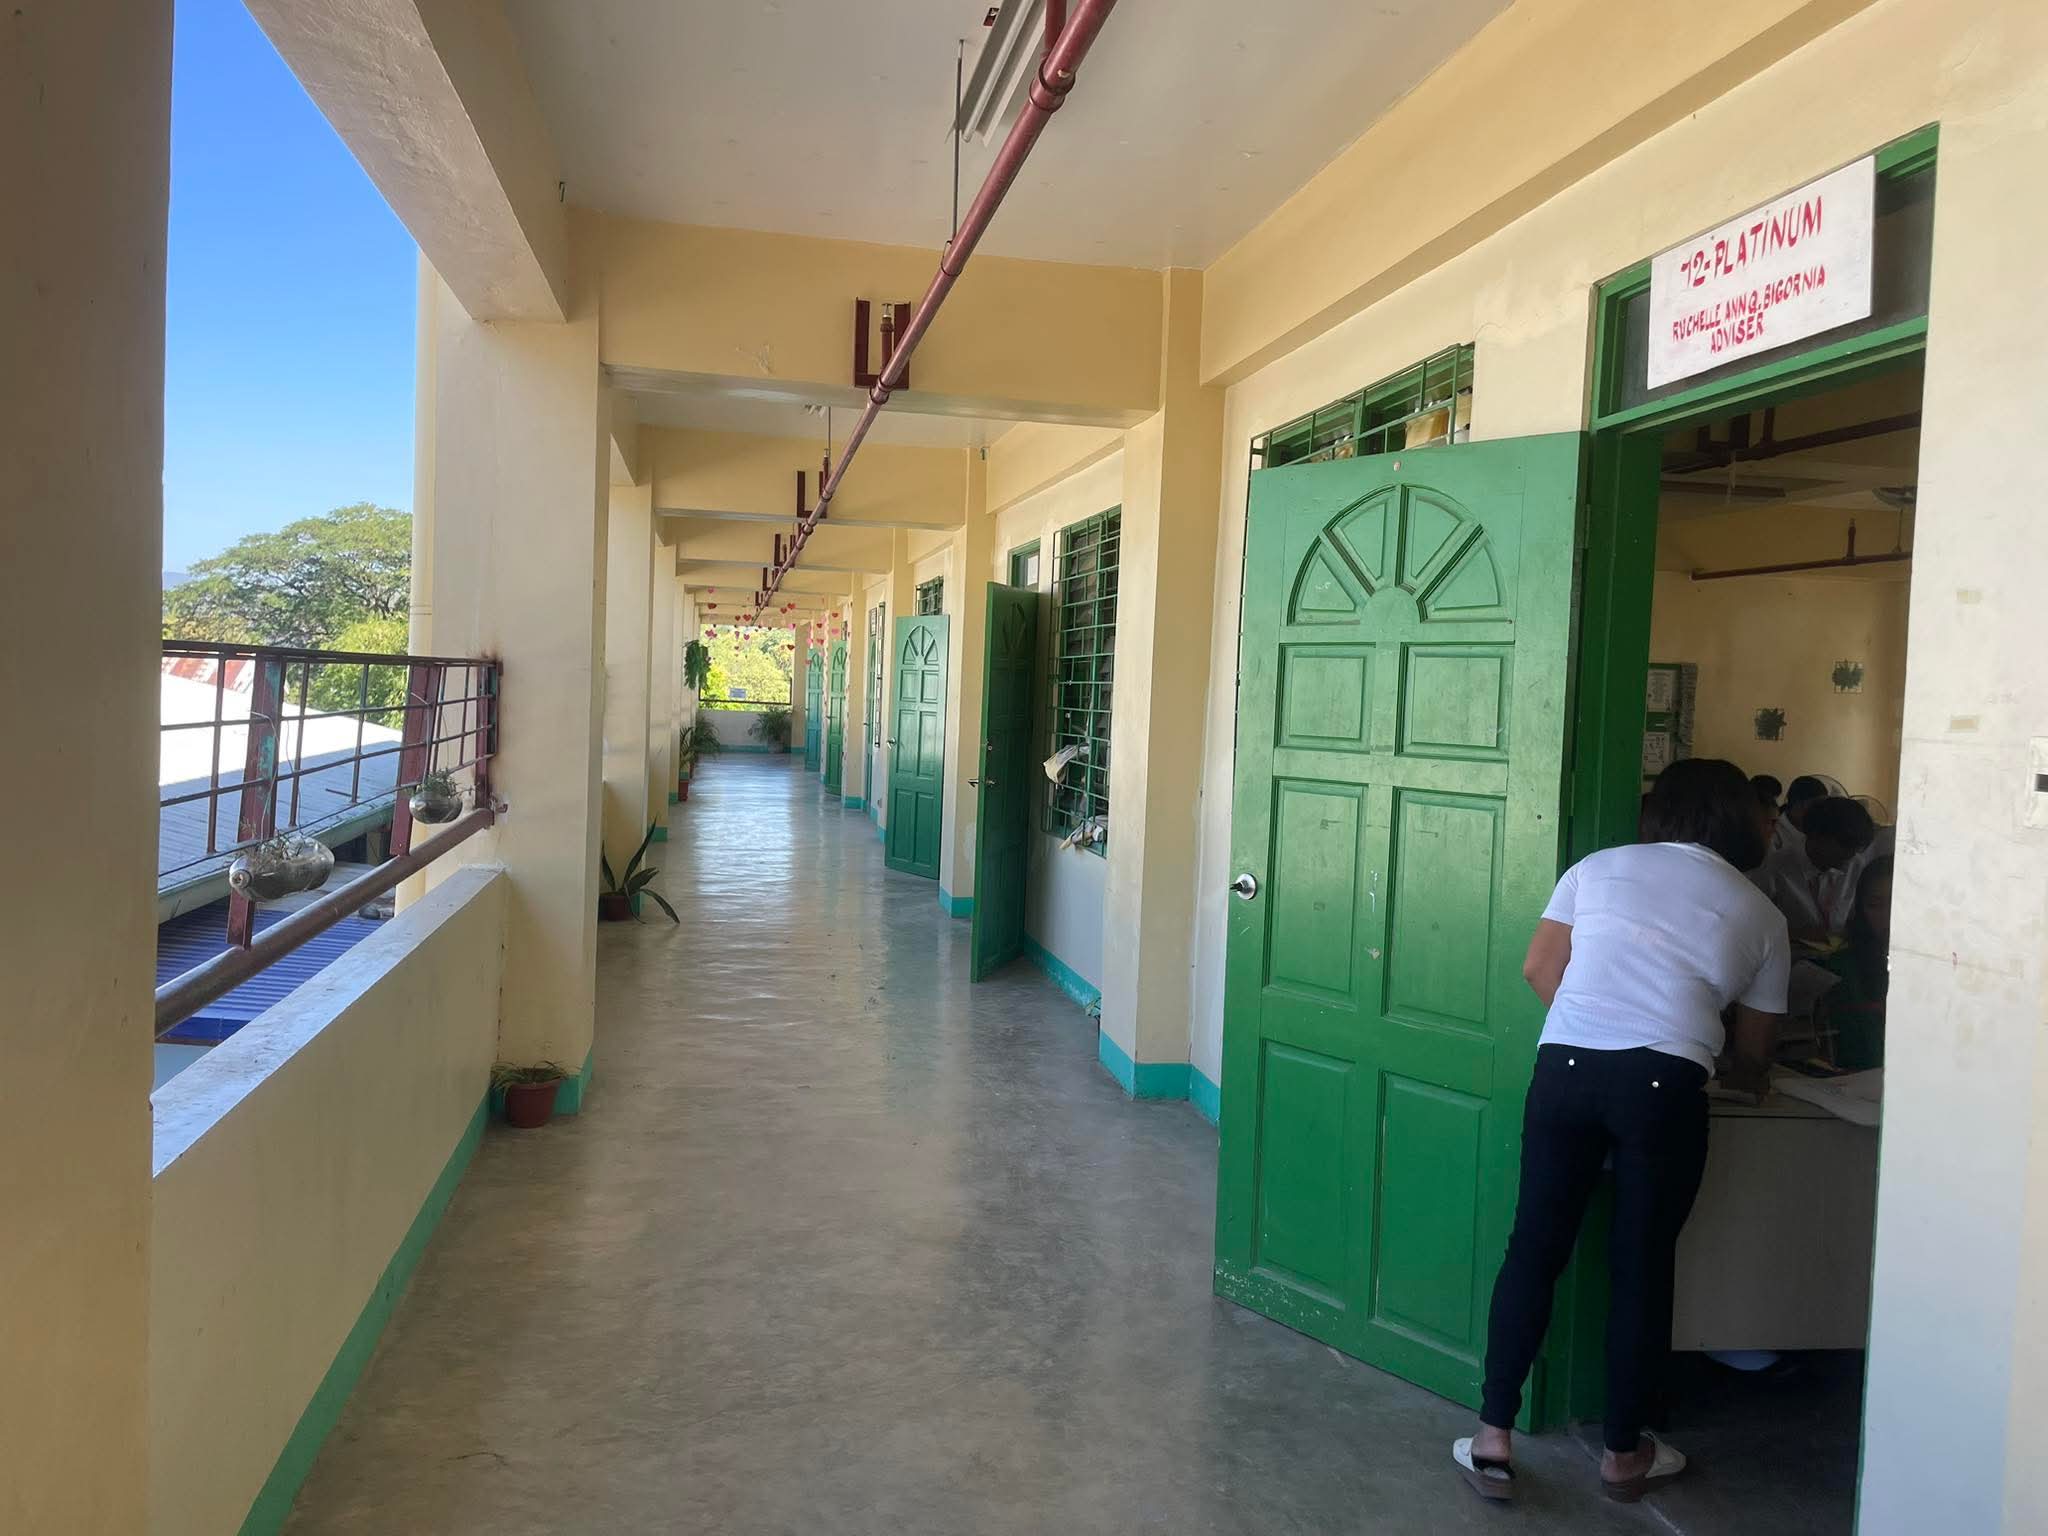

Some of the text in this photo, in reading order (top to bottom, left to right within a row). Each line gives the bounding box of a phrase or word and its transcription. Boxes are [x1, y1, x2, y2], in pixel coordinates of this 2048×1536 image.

[1724, 292, 1747, 321] ANN
[1763, 265, 1825, 310] BIGORNIA
[1710, 312, 1764, 354] ADVISER
